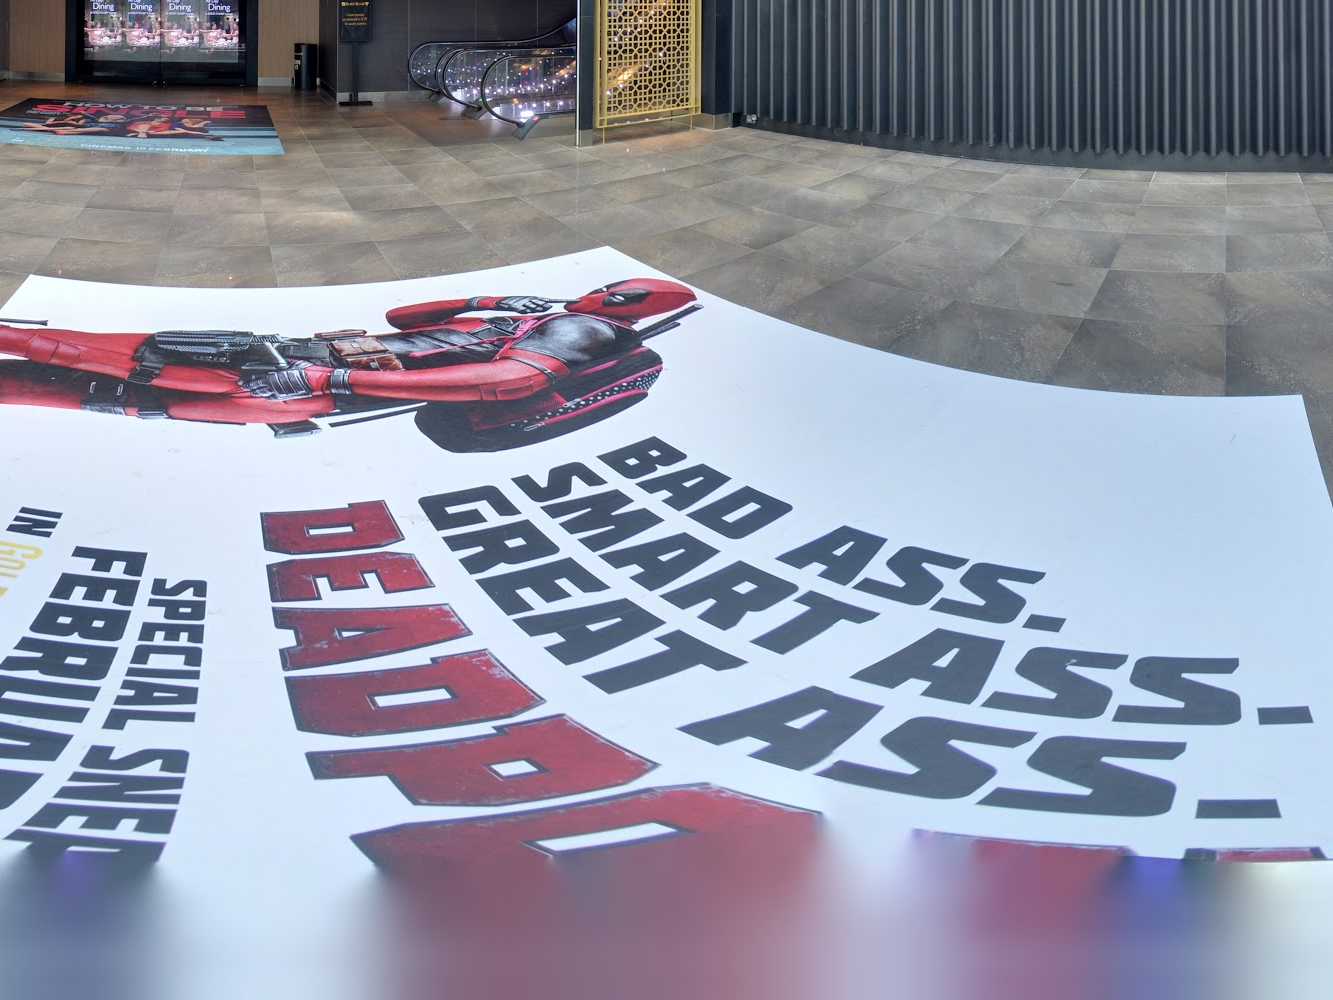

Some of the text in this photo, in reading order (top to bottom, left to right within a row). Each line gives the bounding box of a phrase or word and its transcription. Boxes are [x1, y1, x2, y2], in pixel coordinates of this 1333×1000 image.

[93, 3, 114, 11] Dining
[130, 3, 152, 11] Dining
[169, 3, 191, 12] Dining
[208, 3, 231, 12] Dining
[31, 104, 247, 118] SINGLE
[62, 101, 133, 109] HOW
[5, 506, 64, 538] IN
[596, 436, 1066, 632] BAD ASS.
[511, 461, 1314, 725] SMART ASS.
[101, 578, 208, 730] SPECIAL
[417, 484, 1282, 819] GREAT ASS.
